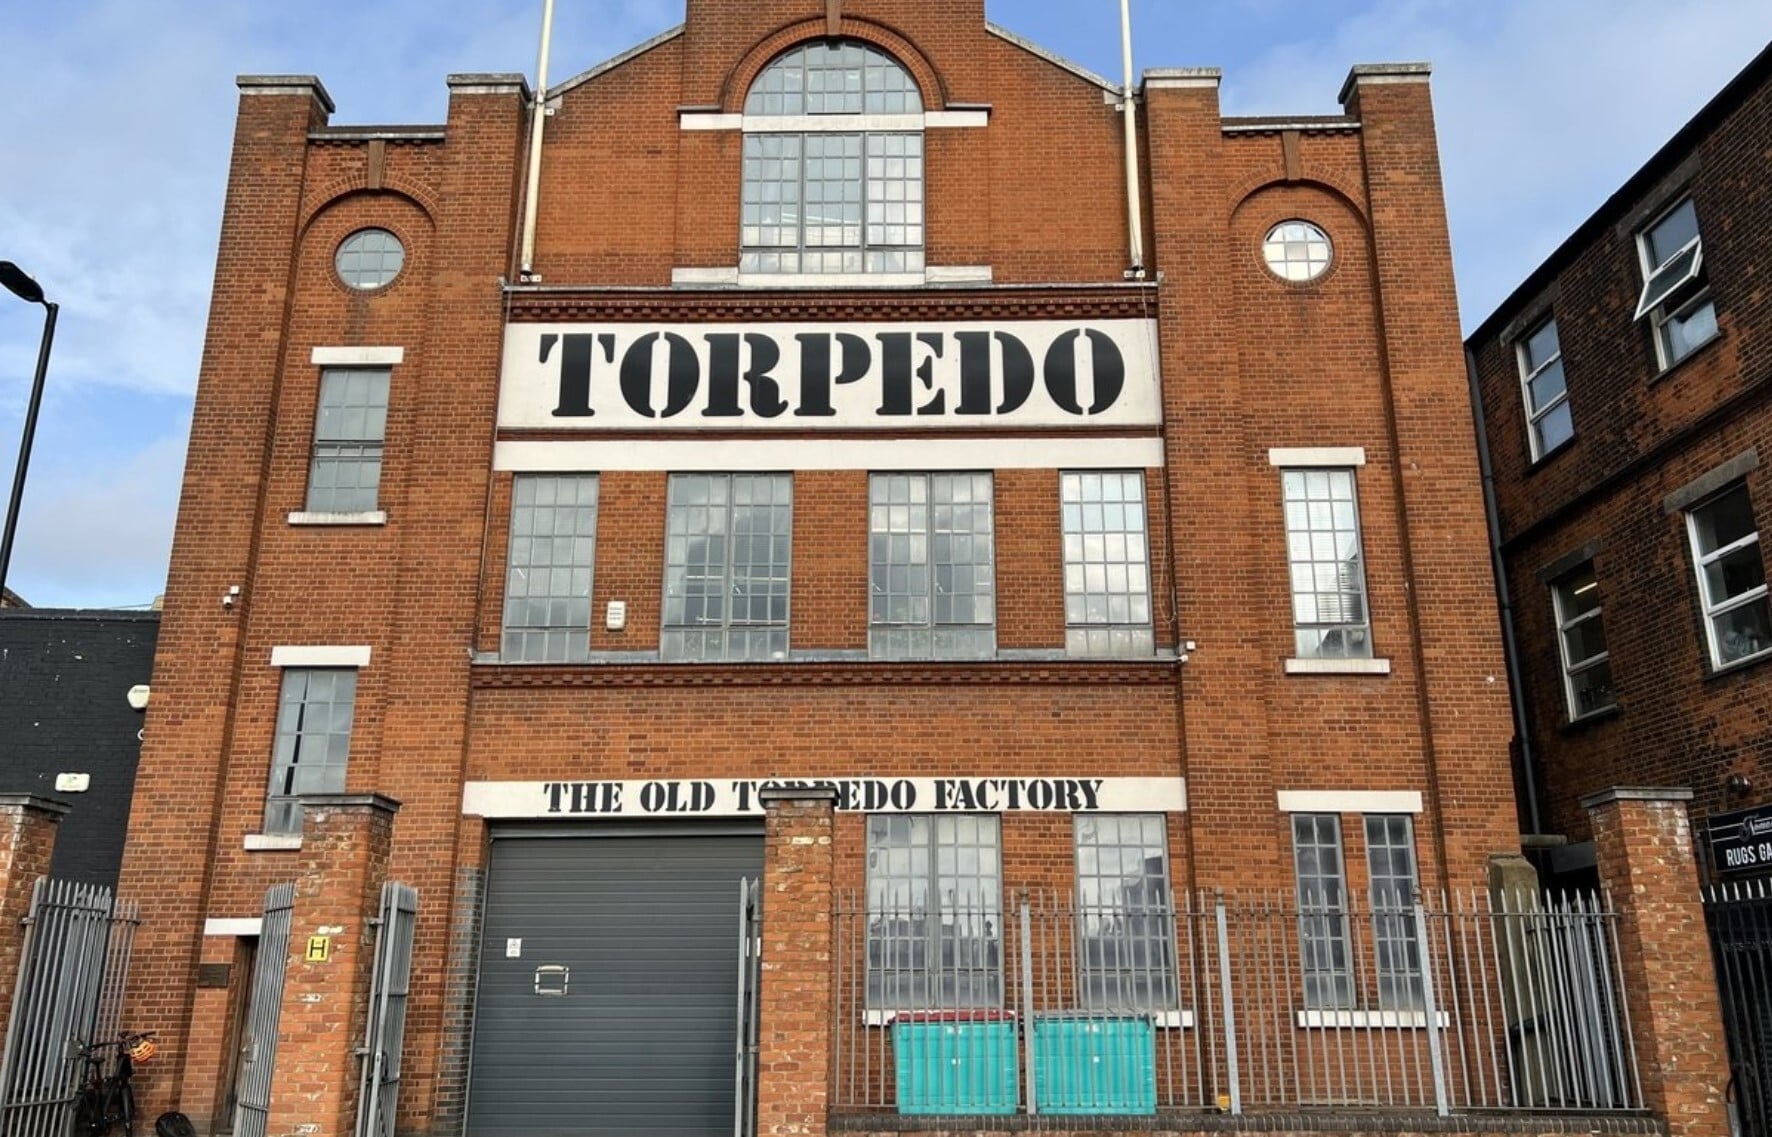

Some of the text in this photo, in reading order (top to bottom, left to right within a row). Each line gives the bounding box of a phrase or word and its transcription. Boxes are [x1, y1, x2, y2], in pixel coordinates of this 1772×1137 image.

[539, 327, 1125, 418] TORPEDO
[543, 779, 1103, 813] THE OLD TEDO FACTORY
[1726, 845, 1757, 866] RUGS
[309, 938, 327, 958] H
